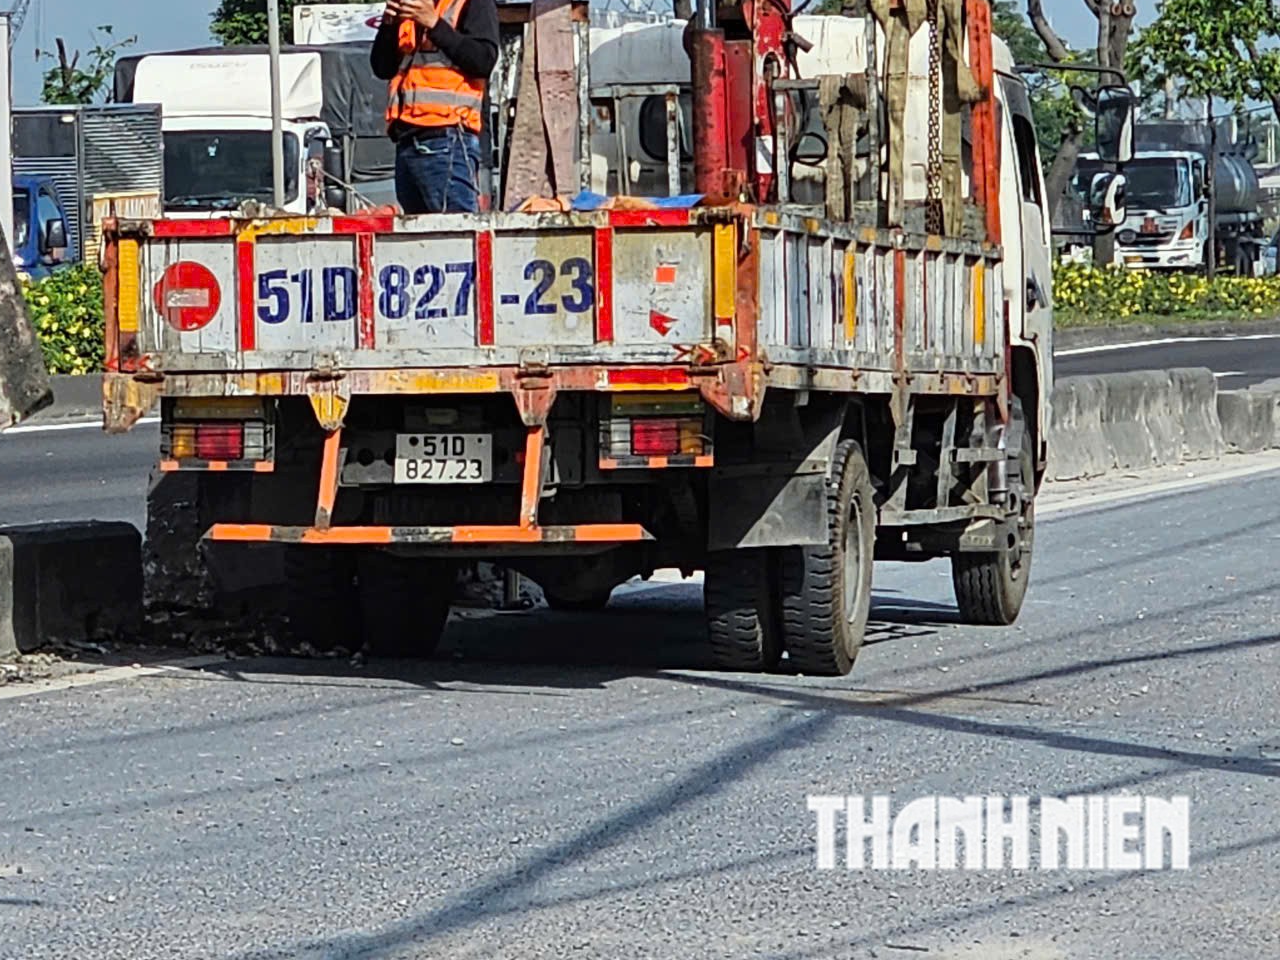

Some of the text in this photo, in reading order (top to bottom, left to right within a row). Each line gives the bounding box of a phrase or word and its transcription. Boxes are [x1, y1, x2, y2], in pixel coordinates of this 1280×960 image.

[257, 267, 358, 325] 51D
[378, 260, 476, 320] 827
[423, 435, 465, 457] 51D
[406, 458, 483, 480] 827.23
